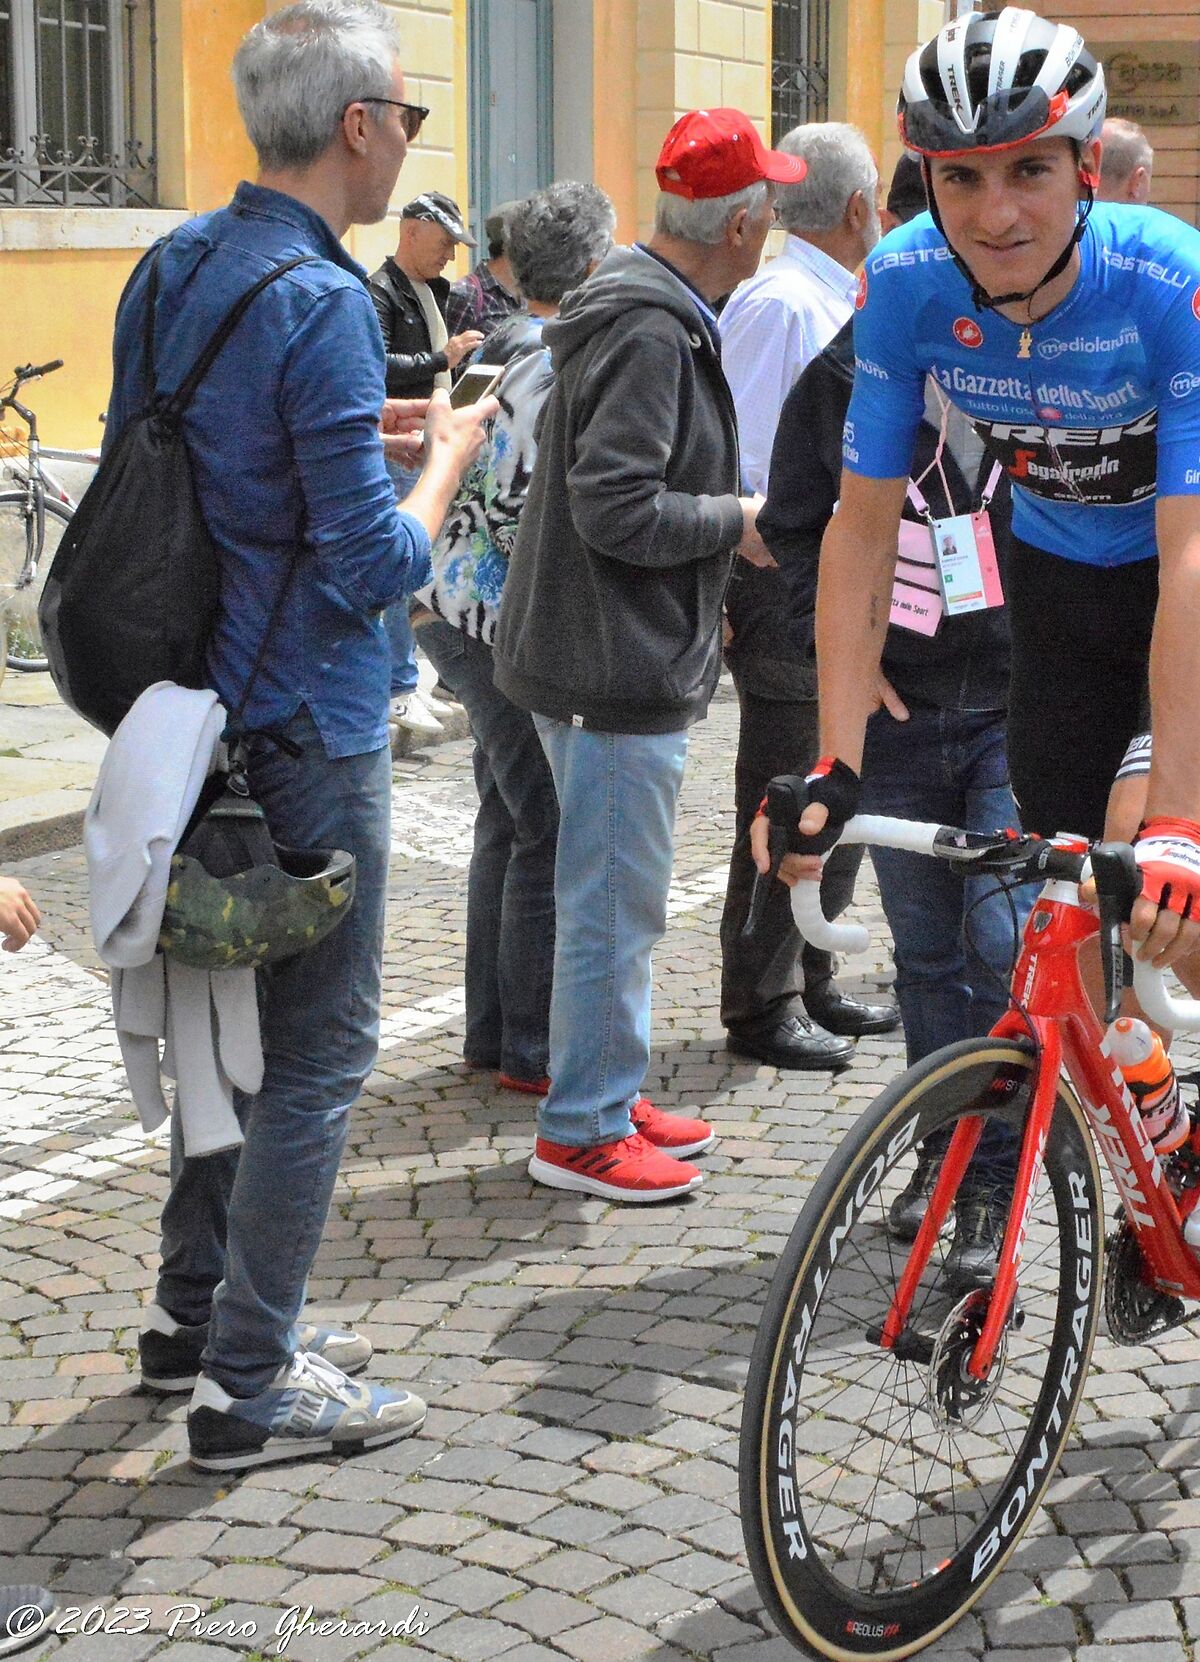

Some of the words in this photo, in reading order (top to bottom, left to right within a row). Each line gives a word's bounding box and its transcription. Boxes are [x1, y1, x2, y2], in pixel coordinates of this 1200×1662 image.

[948, 64, 964, 110] TREK
[871, 246, 956, 276] CASTEL
[931, 364, 950, 390] La
[953, 367, 1032, 400] Gazzetta
[1037, 383, 1084, 409] dello
[1081, 381, 1140, 412] Sport
[966, 400, 1000, 414] Tutto
[972, 409, 1158, 447] REK
[913, 604, 929, 616] Sport
[1020, 953, 1038, 1009] TREK
[1083, 1096, 1157, 1231] TREK
[778, 1112, 921, 1560] BONTRAGER
[971, 1171, 1093, 1582] BONTRAGER
[852, 1621, 884, 1637] AEOLUS
